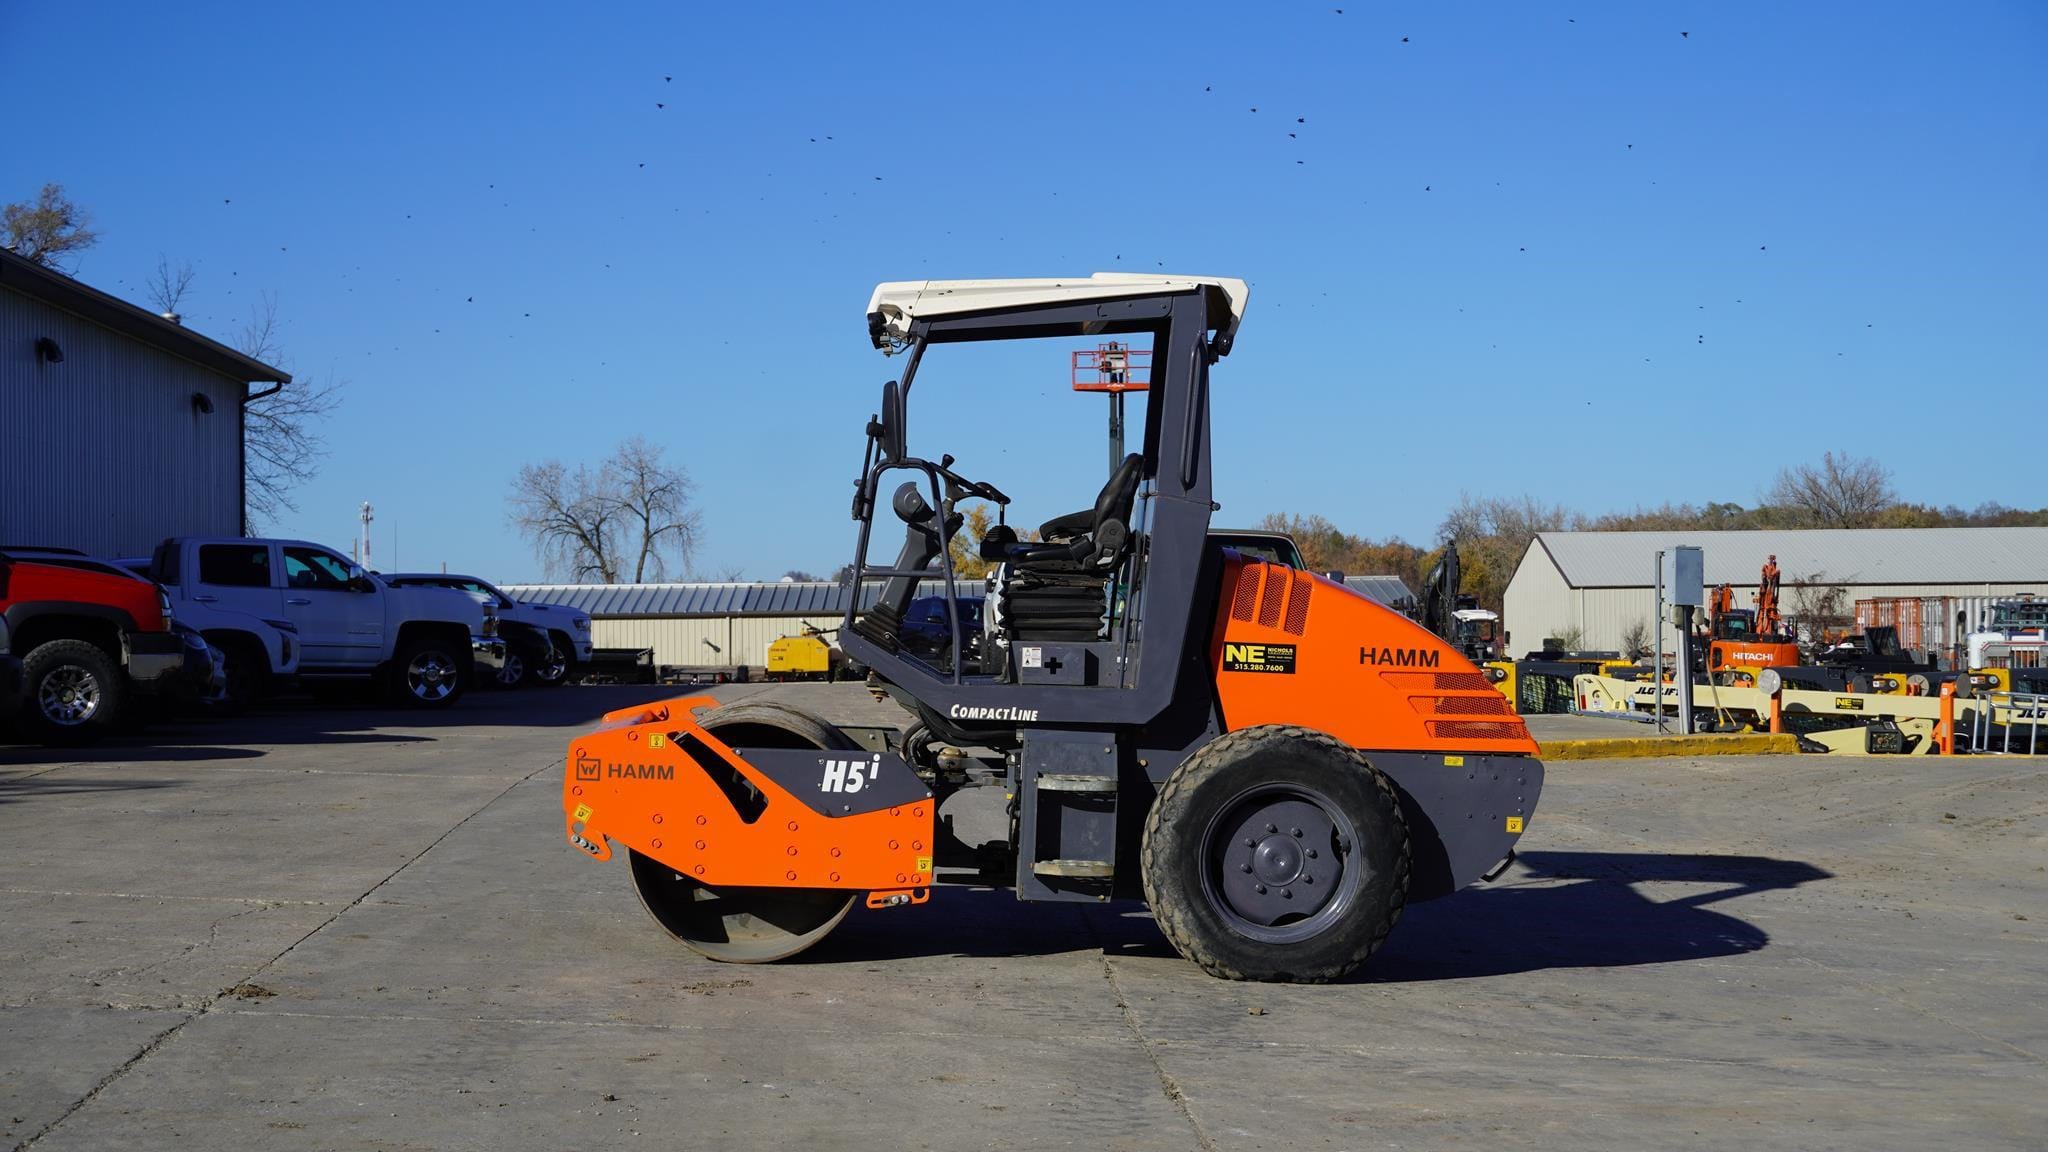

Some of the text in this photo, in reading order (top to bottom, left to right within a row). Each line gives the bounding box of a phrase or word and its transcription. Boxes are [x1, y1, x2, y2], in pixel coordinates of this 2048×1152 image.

[1226, 644, 1266, 663] NE
[1360, 647, 1439, 668] HAMM
[1732, 652, 1773, 661] HITACHI
[1234, 663, 1284, 671] 515.280.7600
[1635, 686, 1656, 695] JLG
[608, 763, 674, 780] HAMM
